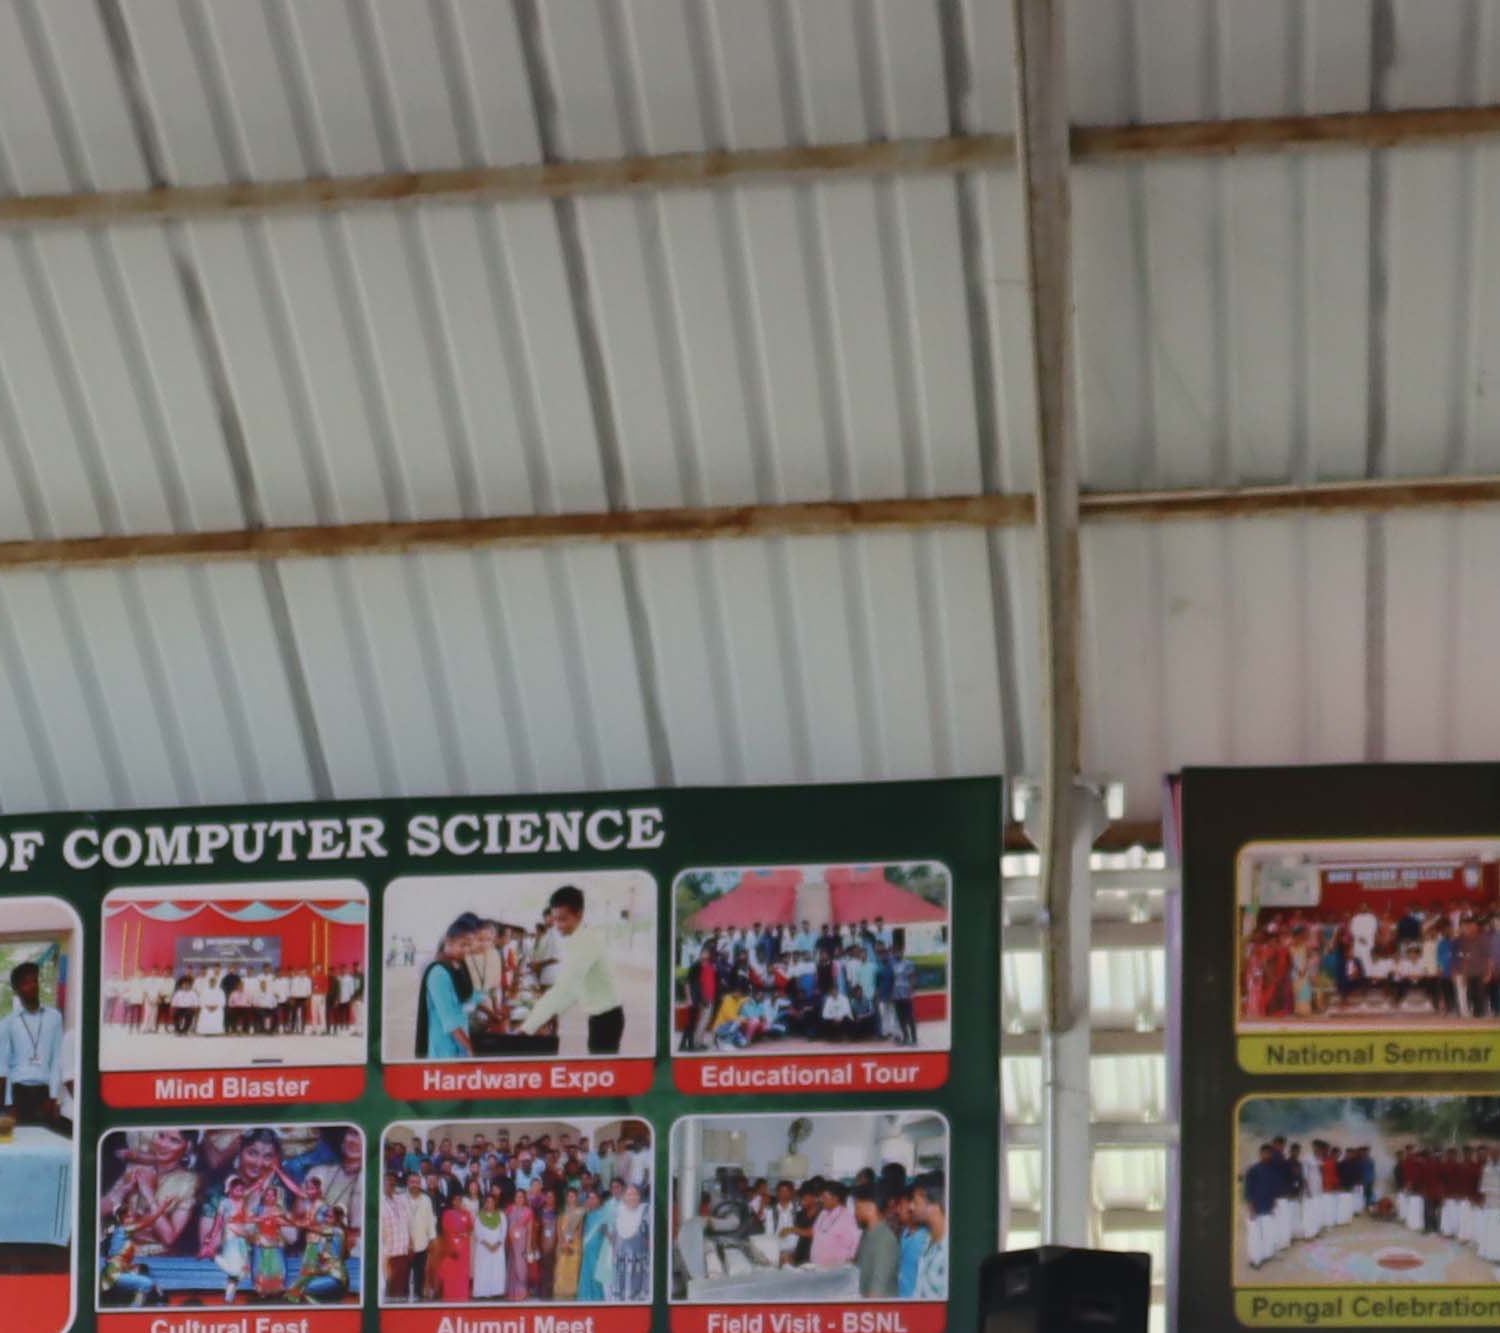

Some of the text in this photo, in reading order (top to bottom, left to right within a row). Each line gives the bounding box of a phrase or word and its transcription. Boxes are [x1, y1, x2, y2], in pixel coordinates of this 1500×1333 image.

[62, 817, 387, 869] COMPUTER
[407, 808, 665, 858] SCIENCE
[1266, 1041, 1492, 1065] National Seminar
[155, 1076, 310, 1099] Mind Blaster
[423, 1067, 615, 1092] Hardware Expo
[701, 1061, 920, 1088] Educational Tour
[1252, 1296, 1342, 1323] Pongal
